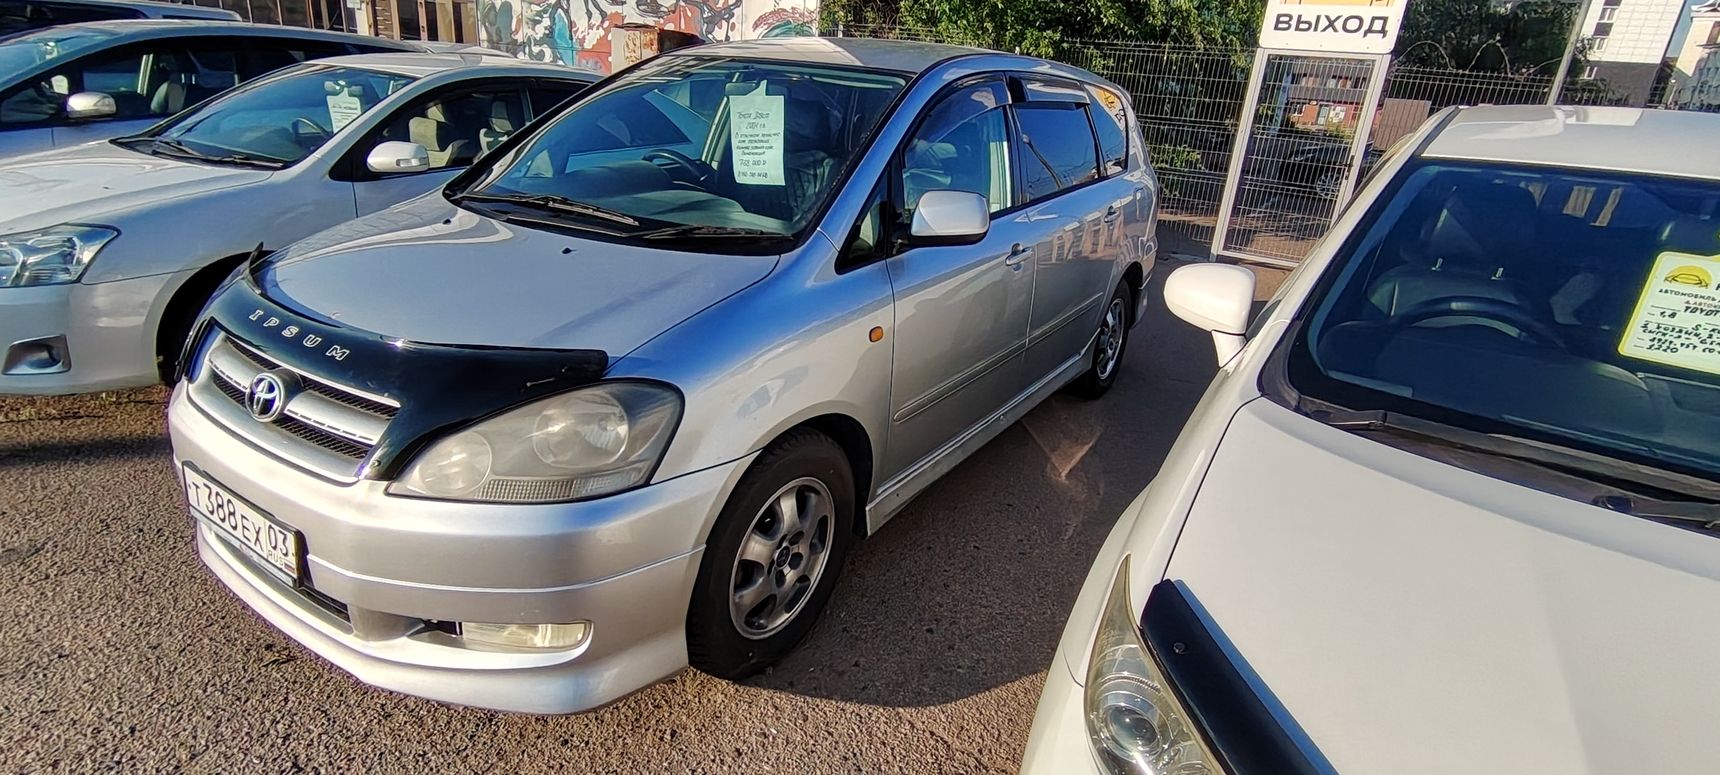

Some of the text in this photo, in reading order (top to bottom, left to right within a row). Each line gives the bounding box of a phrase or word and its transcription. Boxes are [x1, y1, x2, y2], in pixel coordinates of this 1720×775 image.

[1273, 13, 1389, 38] ВЫХОД
[248, 309, 351, 361] IPSUM
[266, 549, 285, 567] RUS
